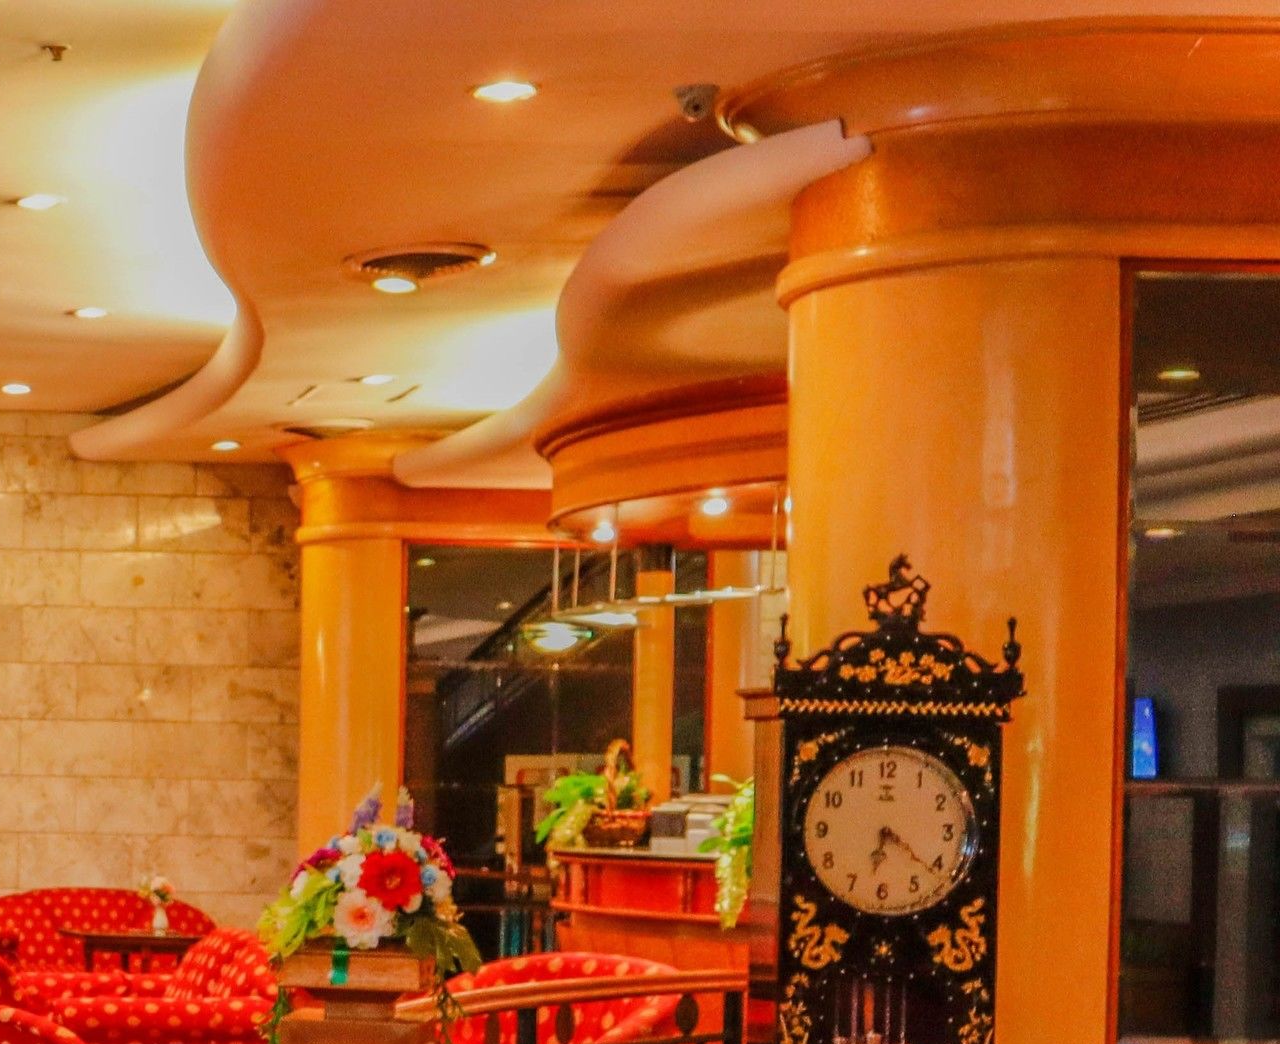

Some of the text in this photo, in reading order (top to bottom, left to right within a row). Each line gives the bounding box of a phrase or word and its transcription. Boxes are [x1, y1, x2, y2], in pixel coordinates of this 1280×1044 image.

[879, 761, 897, 778] 12
[850, 771, 863, 788] 11
[917, 771, 923, 788] 1
[824, 792, 842, 808] 10
[936, 794, 946, 811] 2
[815, 821, 828, 838] 9
[942, 824, 953, 841] 3
[822, 852, 834, 868] 8
[932, 855, 943, 871] 4
[846, 874, 858, 892] 7
[909, 875, 920, 893] 5
[876, 884, 888, 900] 6
